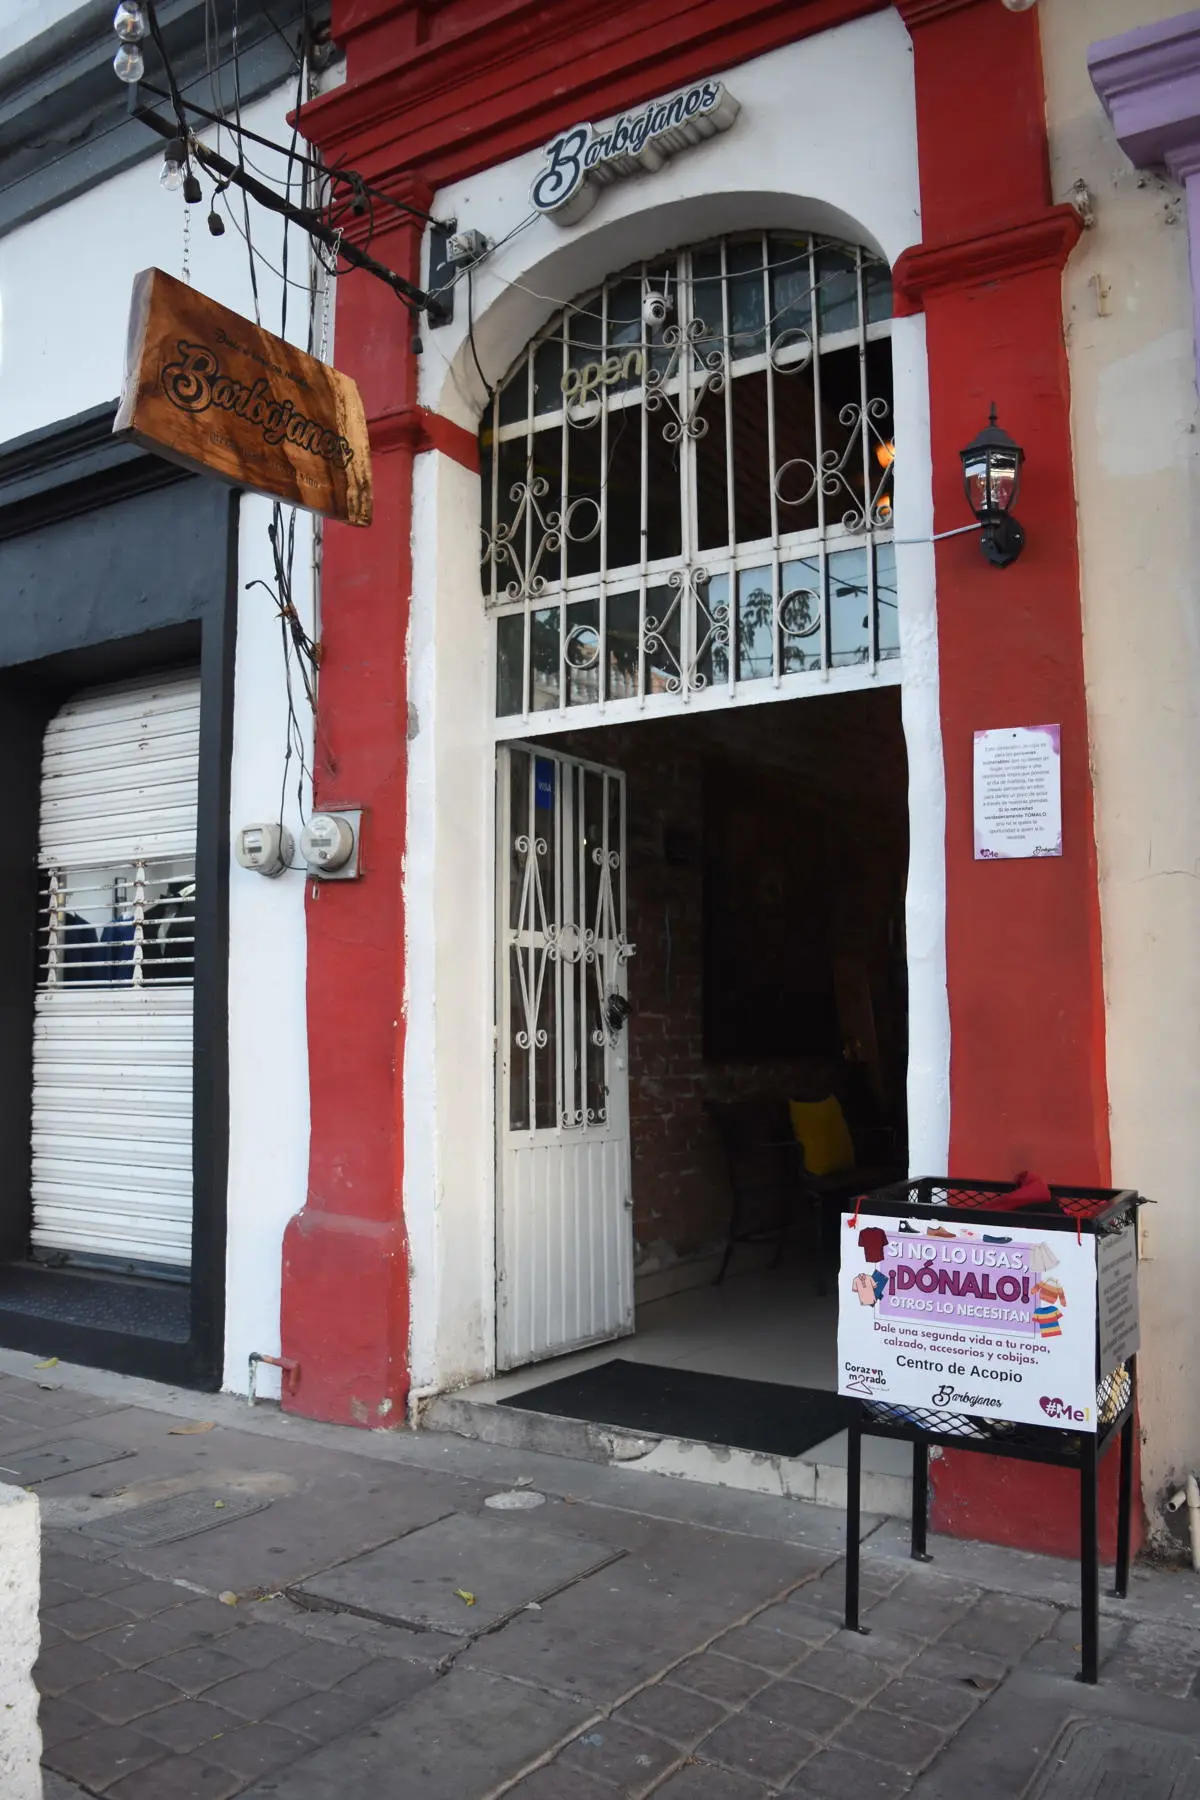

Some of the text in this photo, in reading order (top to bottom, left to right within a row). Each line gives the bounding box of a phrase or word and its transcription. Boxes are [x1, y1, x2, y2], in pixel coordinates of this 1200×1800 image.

[533, 83, 720, 208] Barbajanes
[561, 349, 643, 408] open
[160, 339, 354, 469] Barbajanes
[887, 1240, 1032, 1274] SI NO LO USAS,
[888, 1259, 1031, 1304] ¡DÓNALO!
[890, 1295, 1032, 1325] OTROS LO NECESITAN
[873, 1321, 1051, 1355] Dale una segunda vida a tu ropa,
[883, 1336, 1039, 1366] calzado, accesorios y cobijas.
[895, 1354, 1024, 1384] Centro de Acopio
[931, 1384, 1004, 1408] Barbajanes
